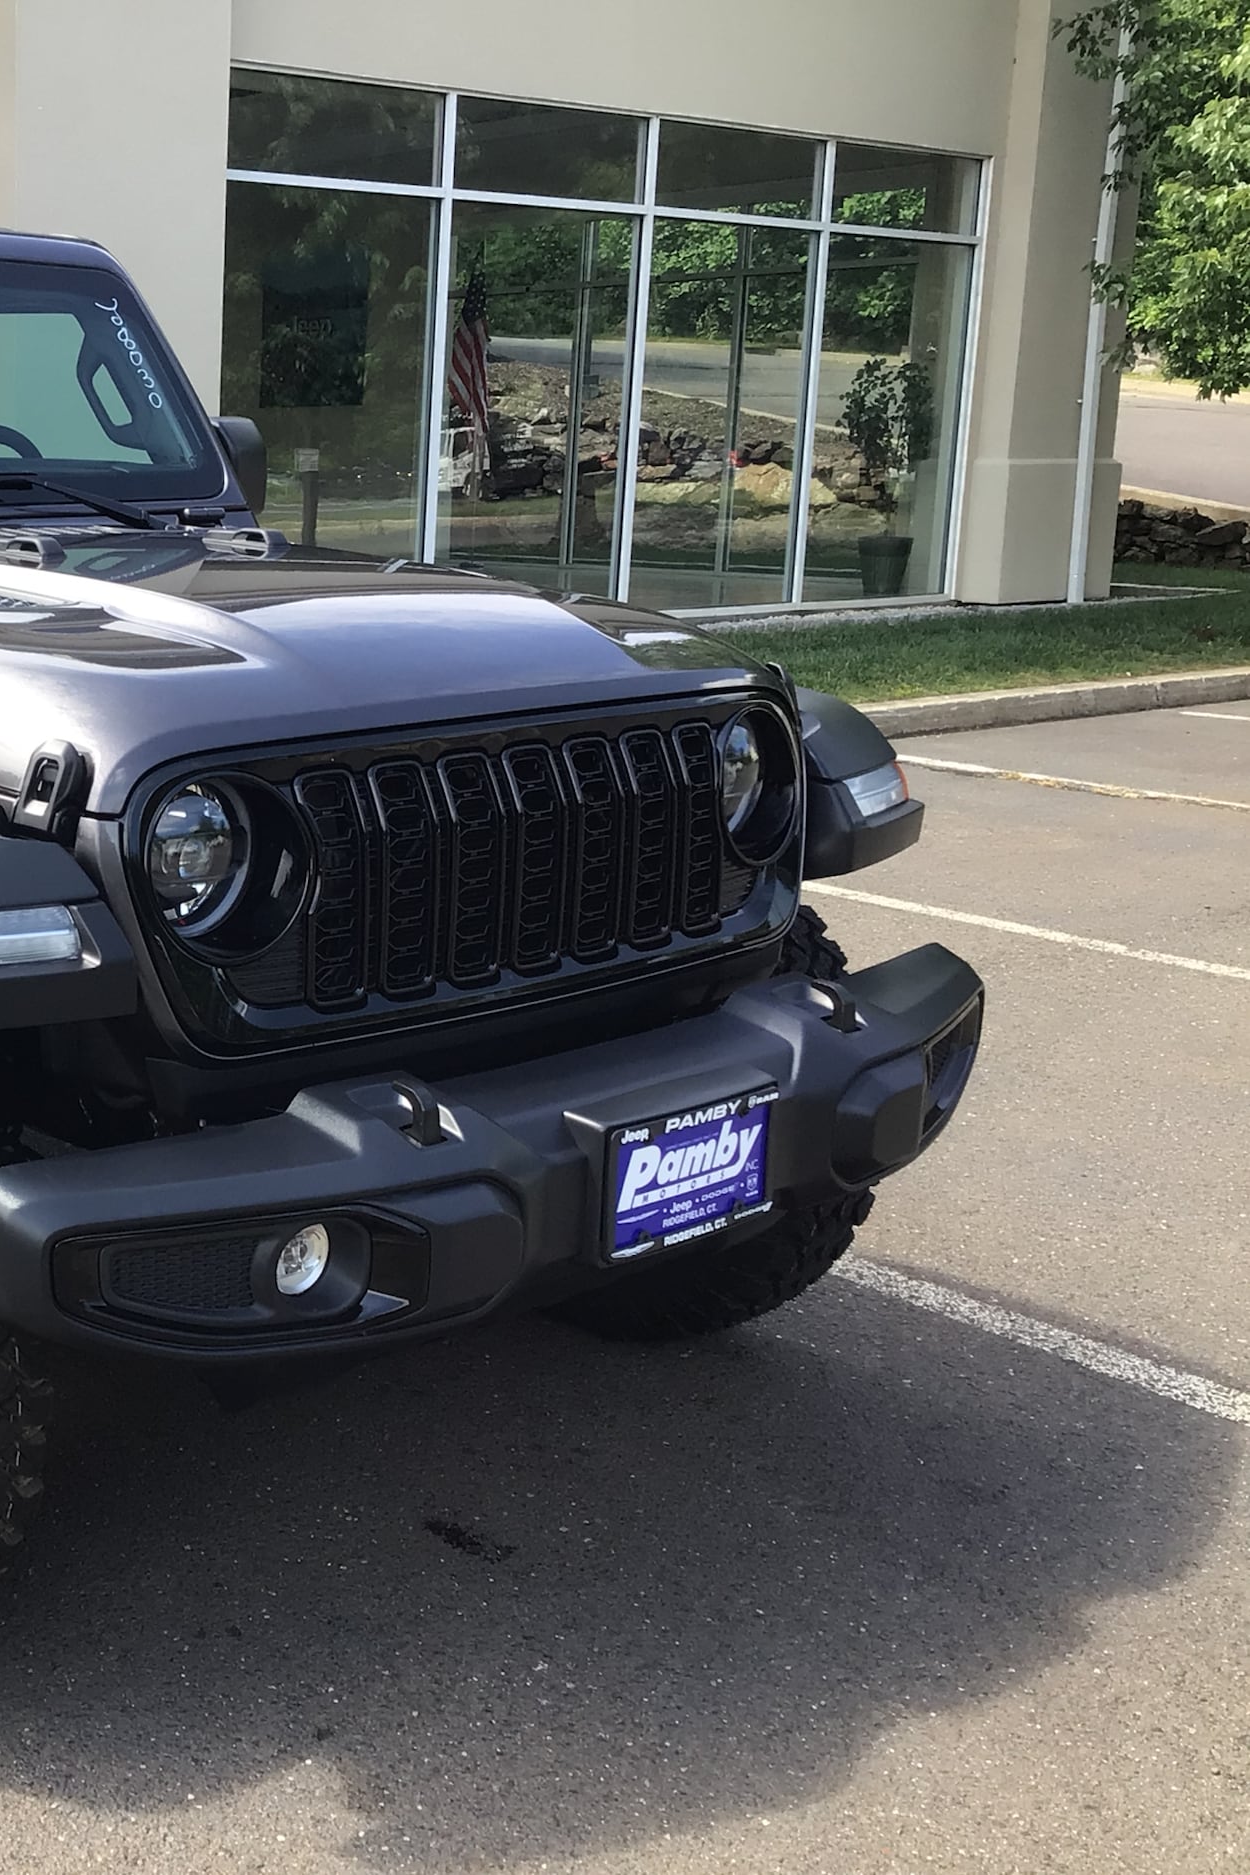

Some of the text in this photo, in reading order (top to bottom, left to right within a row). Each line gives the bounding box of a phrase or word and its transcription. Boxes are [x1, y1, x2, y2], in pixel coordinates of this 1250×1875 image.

[664, 1098, 743, 1134] PAMBY
[621, 1127, 650, 1145] Jeep
[616, 1119, 763, 1214] Pamby
[642, 1170, 727, 1204] MOTORS
[669, 1199, 693, 1214] Jeep
[700, 1184, 736, 1202] DODGE
